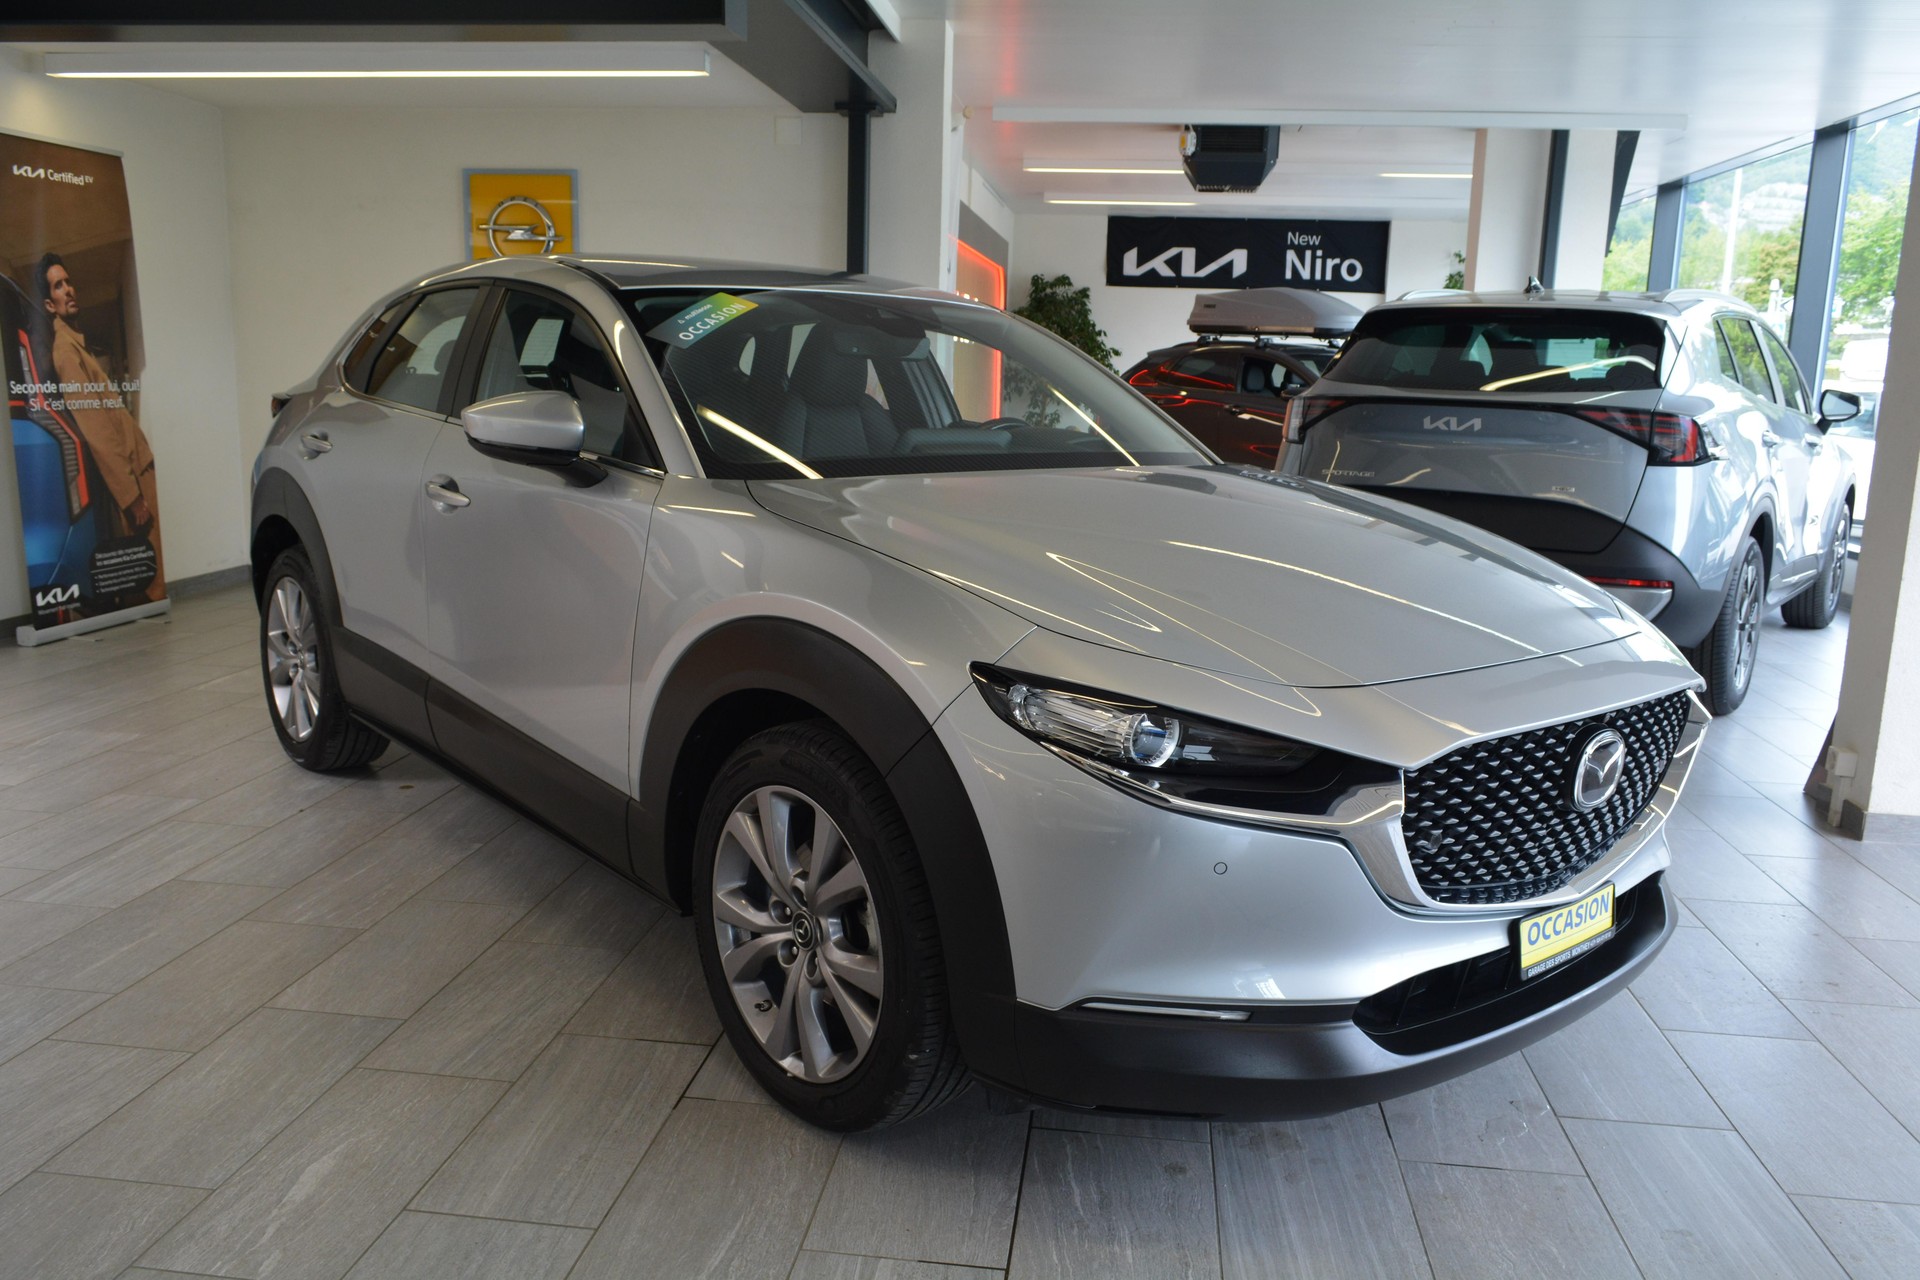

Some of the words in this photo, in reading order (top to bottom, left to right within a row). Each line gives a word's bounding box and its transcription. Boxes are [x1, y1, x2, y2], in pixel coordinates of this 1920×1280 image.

[12, 164, 46, 179] KIA
[47, 169, 84, 186] Certified
[1287, 231, 1322, 246] New
[1123, 246, 1248, 279] KIA
[1284, 249, 1363, 282] Niro
[678, 302, 748, 341] OCCASION
[9, 380, 57, 394] Seconde
[58, 380, 82, 393] main
[83, 382, 106, 395] pour
[121, 379, 141, 392] oui!
[29, 398, 41, 411] Si
[43, 398, 66, 411] c'est
[66, 398, 101, 411] comme
[103, 396, 126, 409] neuf.
[1422, 415, 1483, 432] KIA
[35, 583, 81, 607] KIA
[1527, 891, 1610, 946] OCCASION
